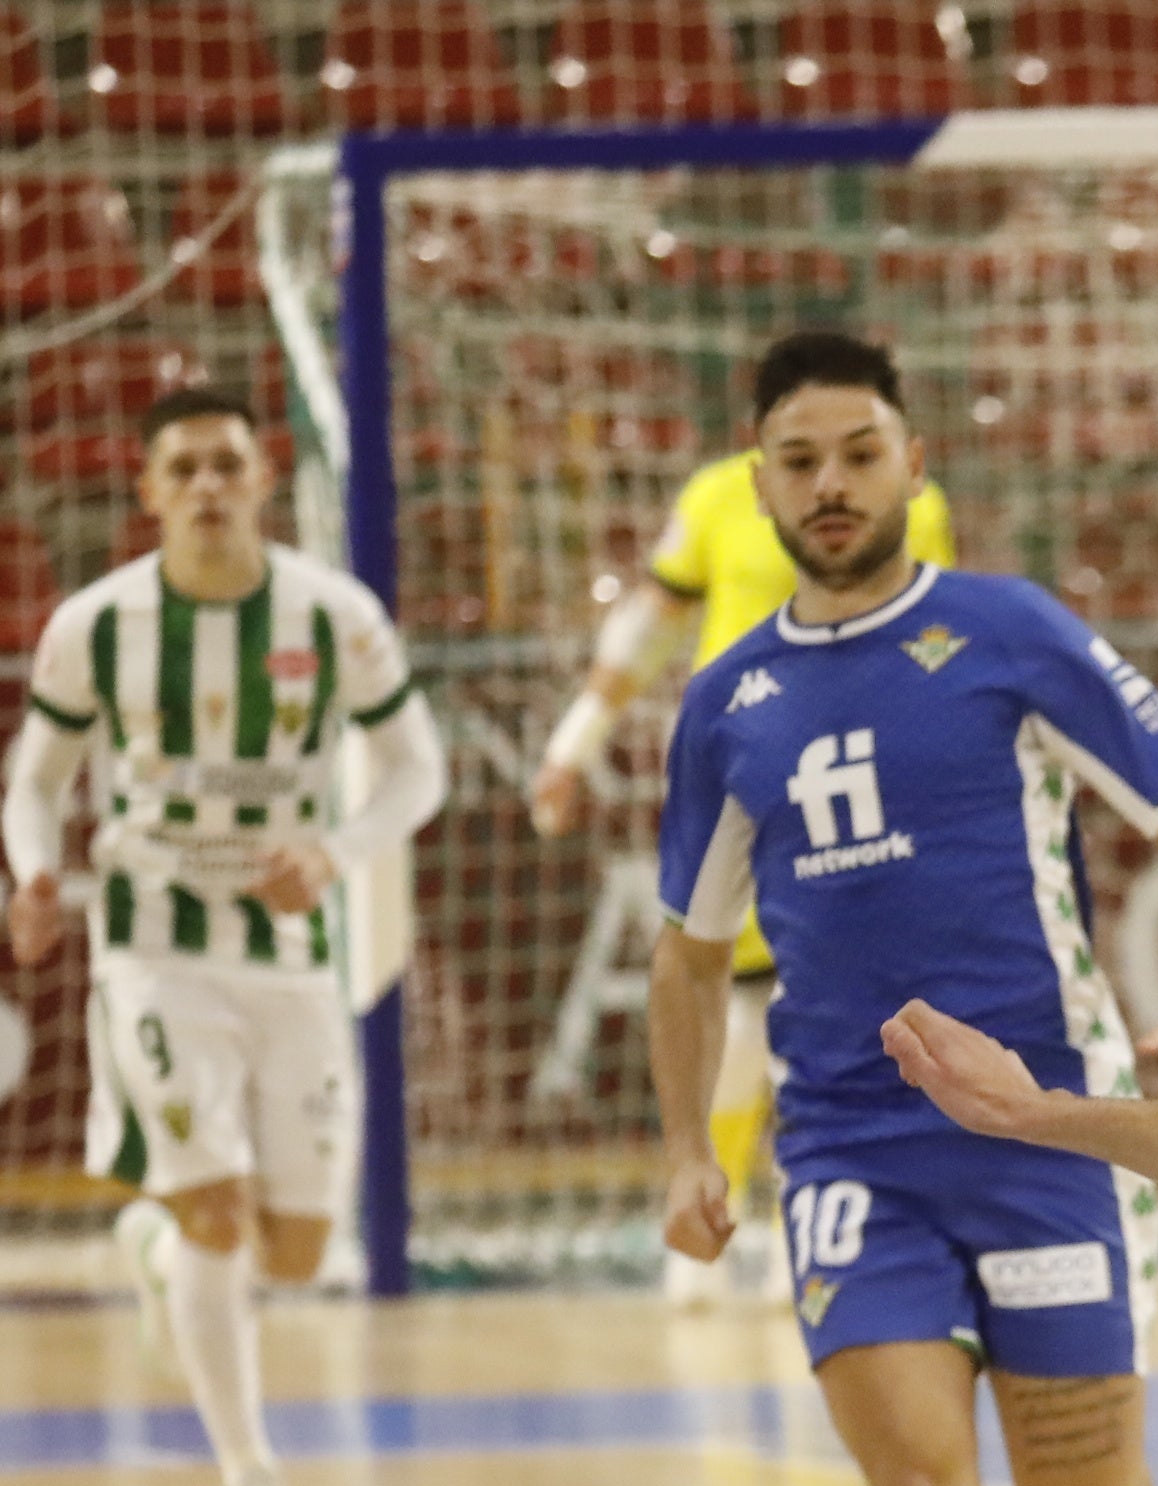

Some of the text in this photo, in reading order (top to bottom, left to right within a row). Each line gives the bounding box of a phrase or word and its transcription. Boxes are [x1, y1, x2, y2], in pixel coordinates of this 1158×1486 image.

[786, 728, 886, 850] fi
[793, 831, 916, 880] network
[136, 1012, 173, 1081] 9
[791, 1179, 872, 1277] 10
